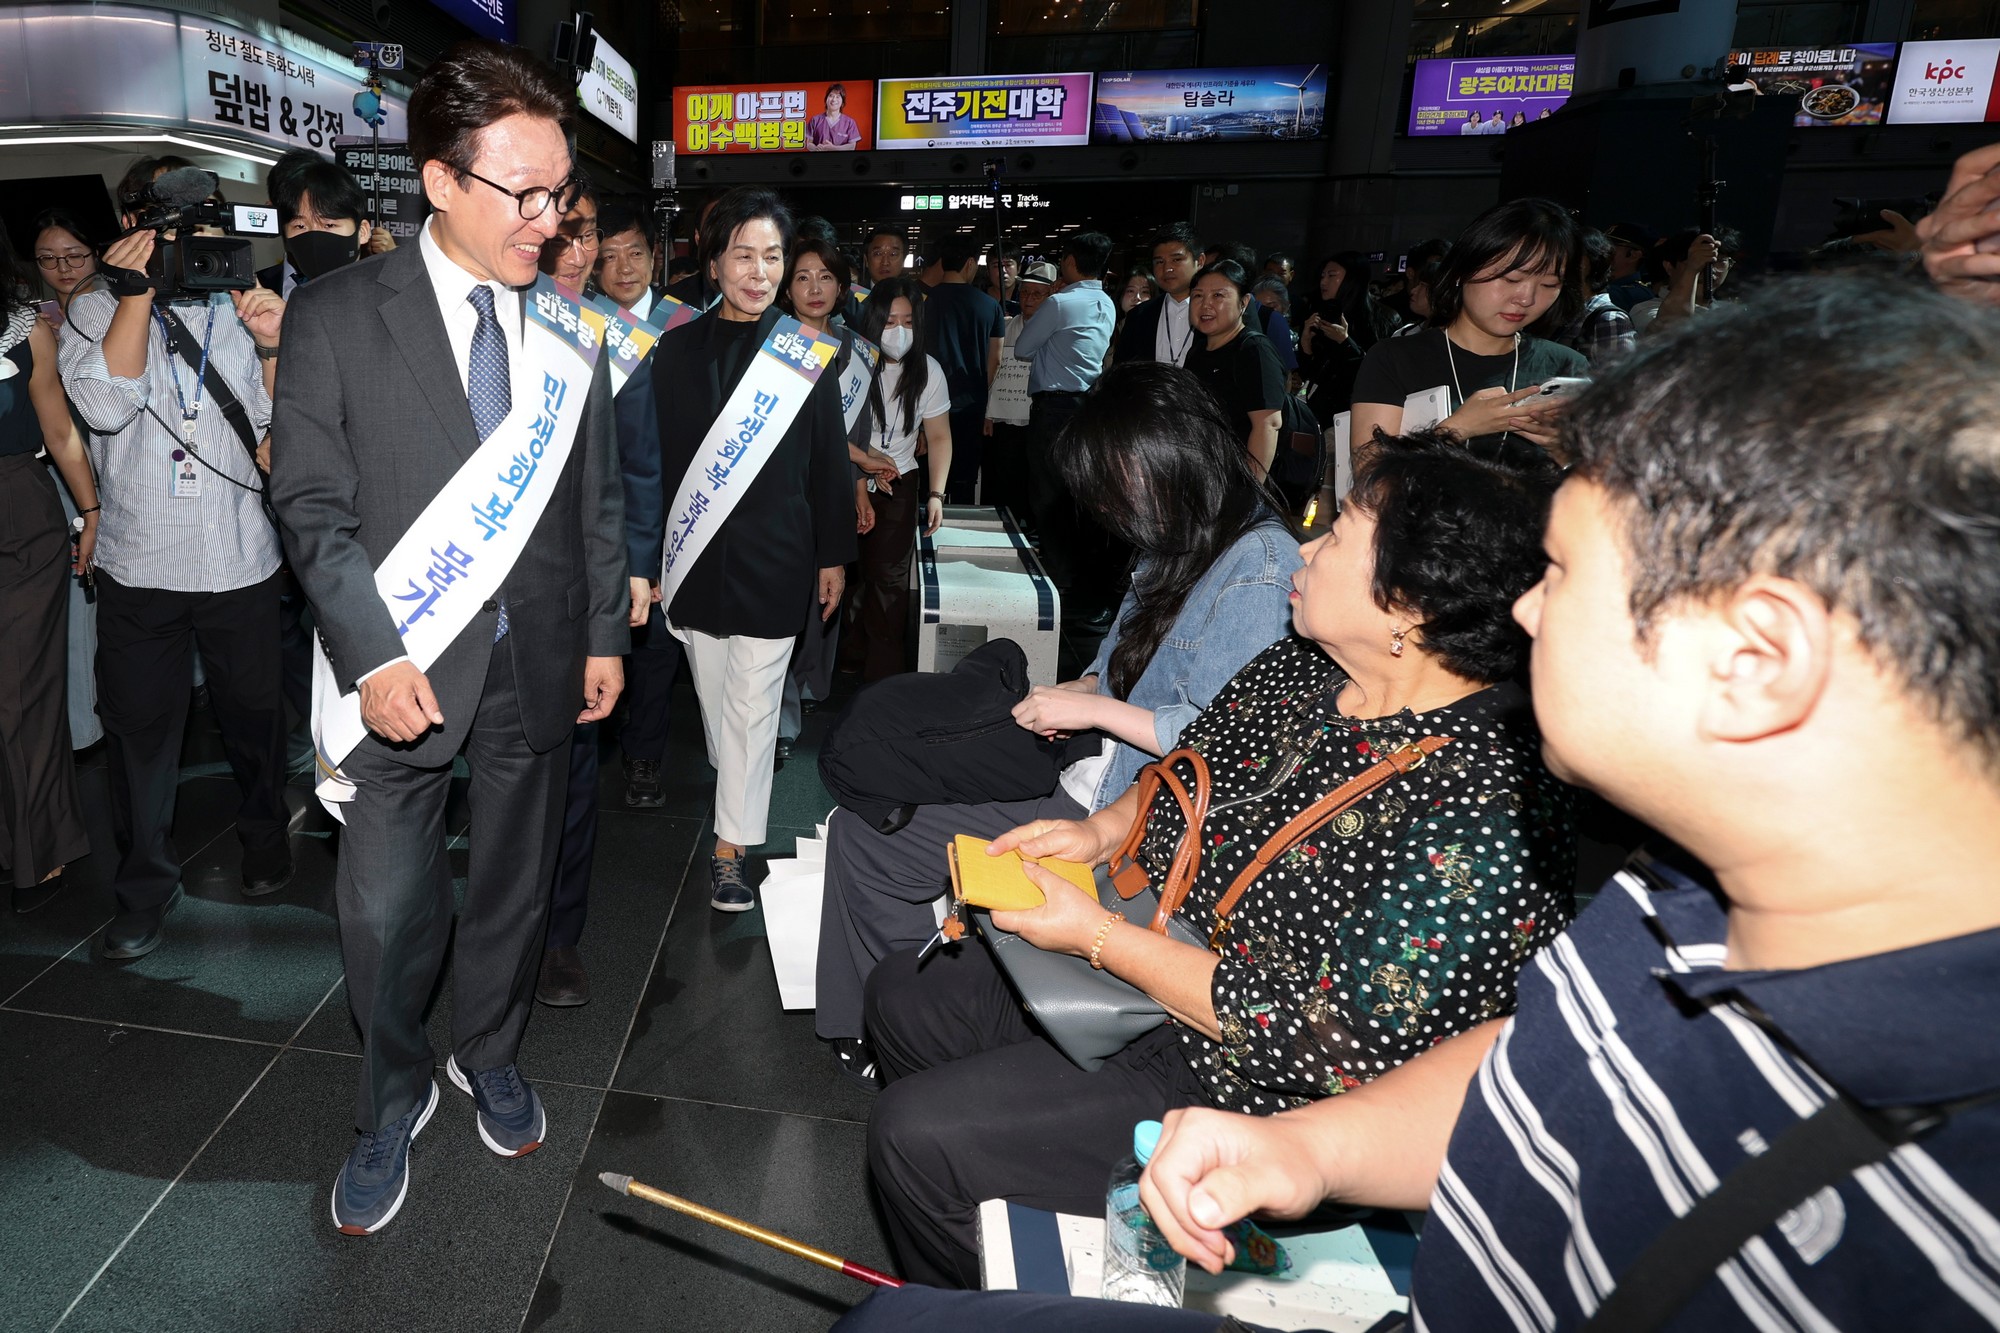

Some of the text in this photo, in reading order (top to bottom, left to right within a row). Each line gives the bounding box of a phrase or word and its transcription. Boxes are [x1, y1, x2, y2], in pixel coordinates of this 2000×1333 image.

[206, 28, 315, 88] 청년 철도 특화도시락
[1728, 49, 1856, 66] 맛이 답례로 찾아옵니다
[1925, 59, 1966, 84] kpc
[208, 69, 272, 133] 덮밥
[280, 96, 299, 138] &
[688, 90, 806, 122] 어깨 아프면
[904, 87, 1065, 122] 전주기전대학
[1184, 90, 1235, 108] 탑솔라
[1908, 86, 1974, 98] 한국생산성본부
[687, 121, 806, 150] 여수백병원
[948, 194, 994, 209] 열차타는
[536, 292, 596, 350] 민주당
[604, 322, 639, 361] 주당
[772, 333, 821, 370] 민주당
[706, 389, 779, 491] 민생회복
[392, 370, 567, 638] 민생회복 물가
